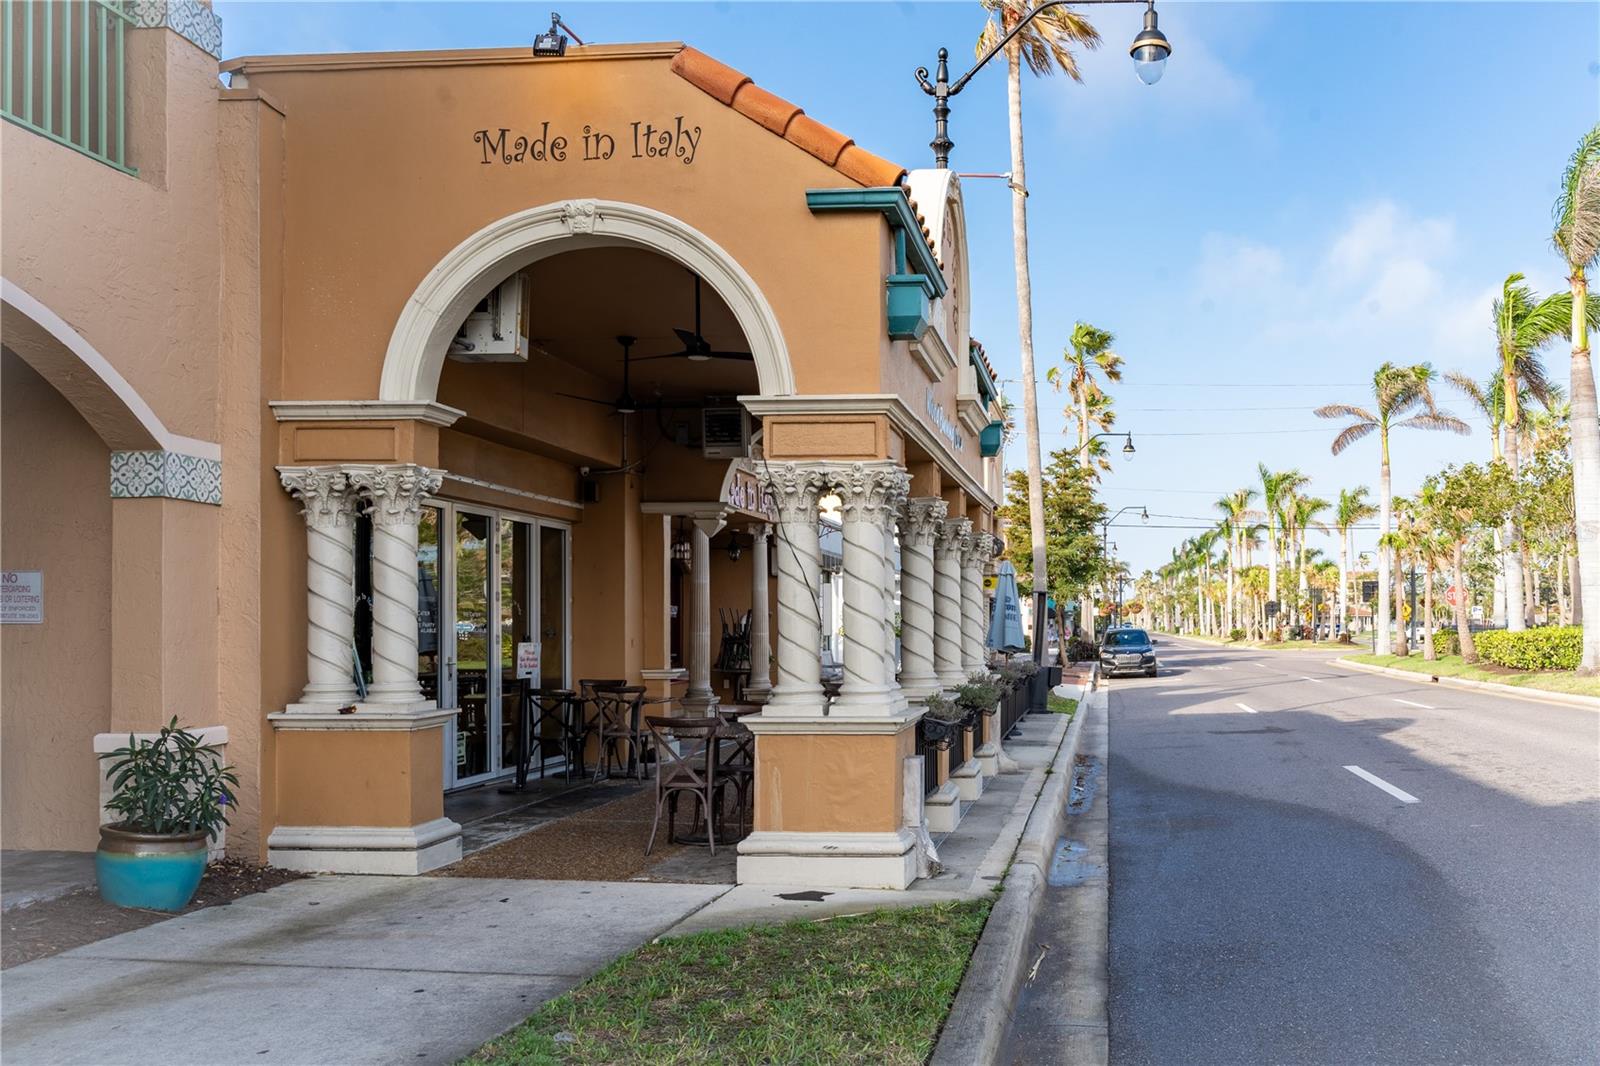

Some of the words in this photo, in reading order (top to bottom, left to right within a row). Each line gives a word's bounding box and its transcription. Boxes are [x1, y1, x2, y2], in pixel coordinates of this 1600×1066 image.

[473, 121, 568, 165] Made
[582, 125, 615, 161] in
[630, 115, 702, 165] Italy
[2, 573, 18, 583] NO
